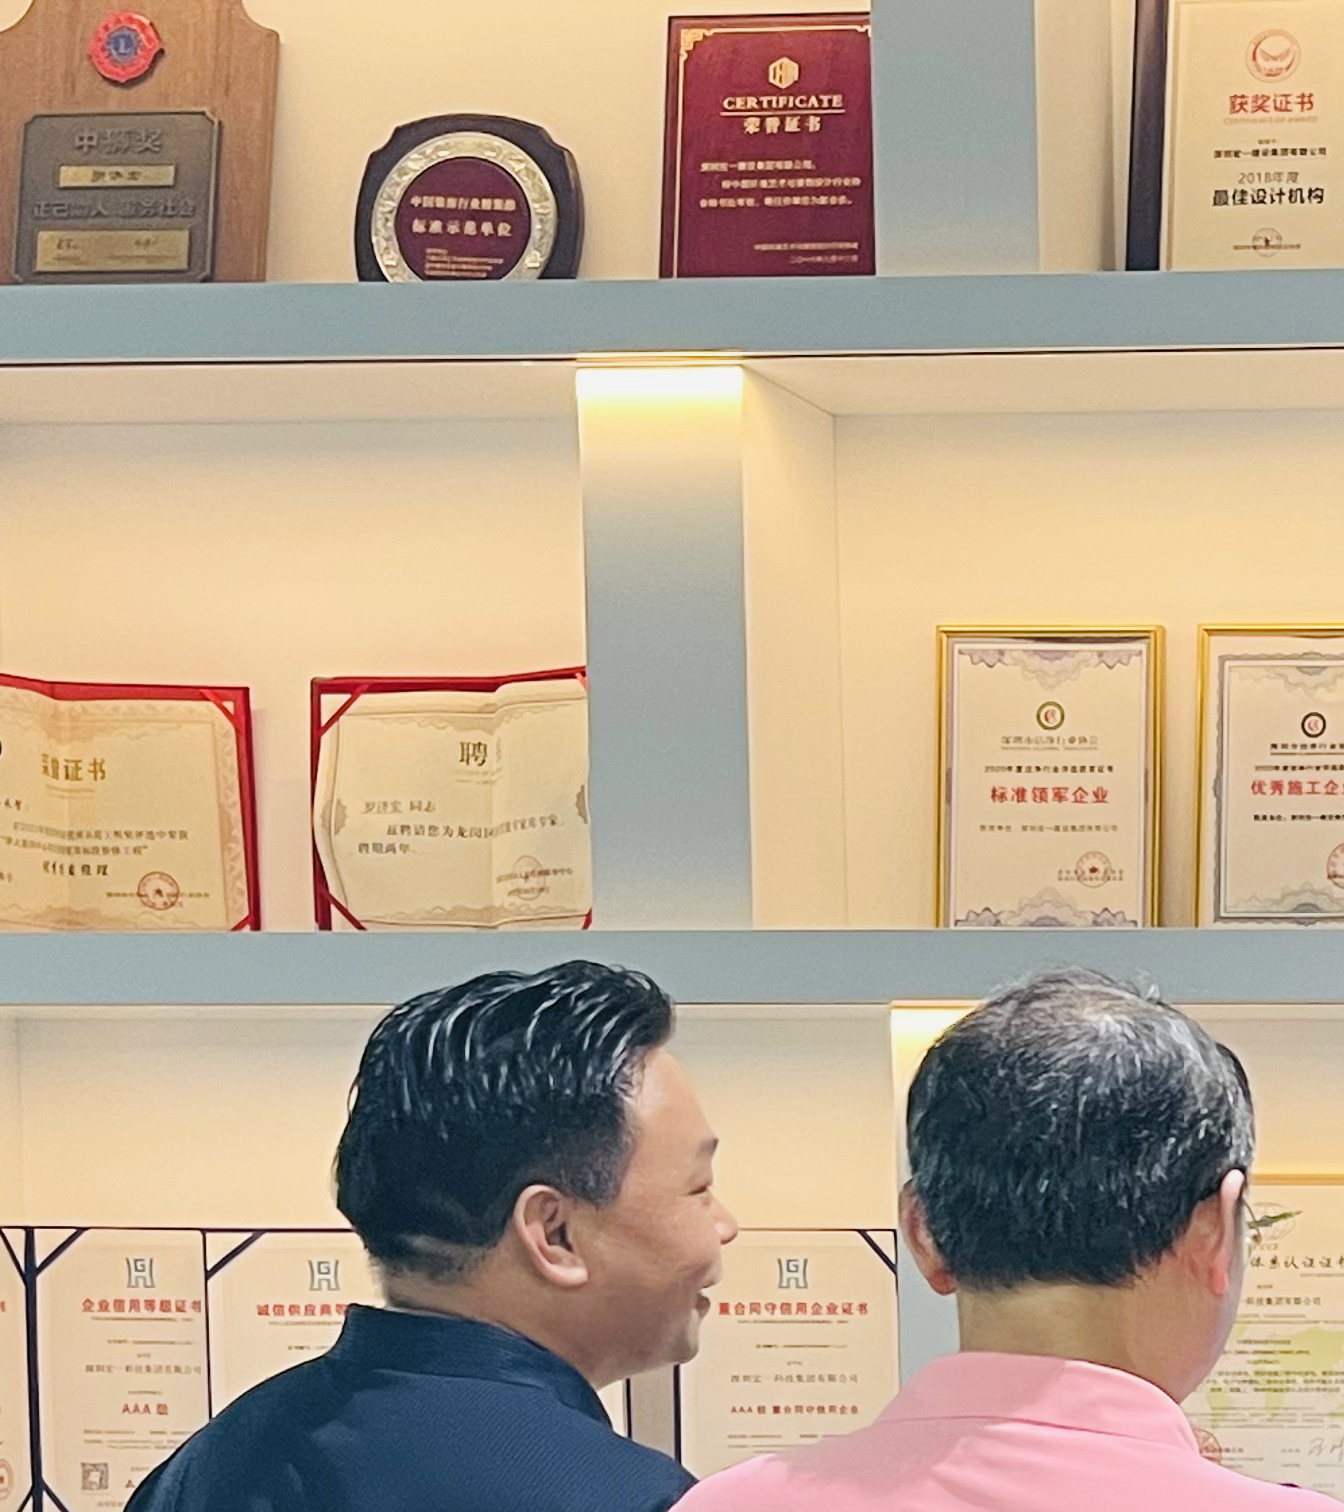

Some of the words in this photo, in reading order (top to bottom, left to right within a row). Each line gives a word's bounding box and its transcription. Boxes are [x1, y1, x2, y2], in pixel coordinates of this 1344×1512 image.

[723, 95, 843, 110] CERTIFICATE
[1229, 93, 1314, 114] 获奖证书
[743, 116, 821, 134] 荣誉证书
[1238, 172, 1299, 184] 2018年度
[1213, 188, 1324, 206] 最佳设计机构
[990, 786, 1110, 804] 标准领军企业
[82, 1298, 202, 1314] 企业信用等级证书
[718, 1302, 869, 1316] 重合同守信用企业证书
[122, 1403, 151, 1416] AAA
